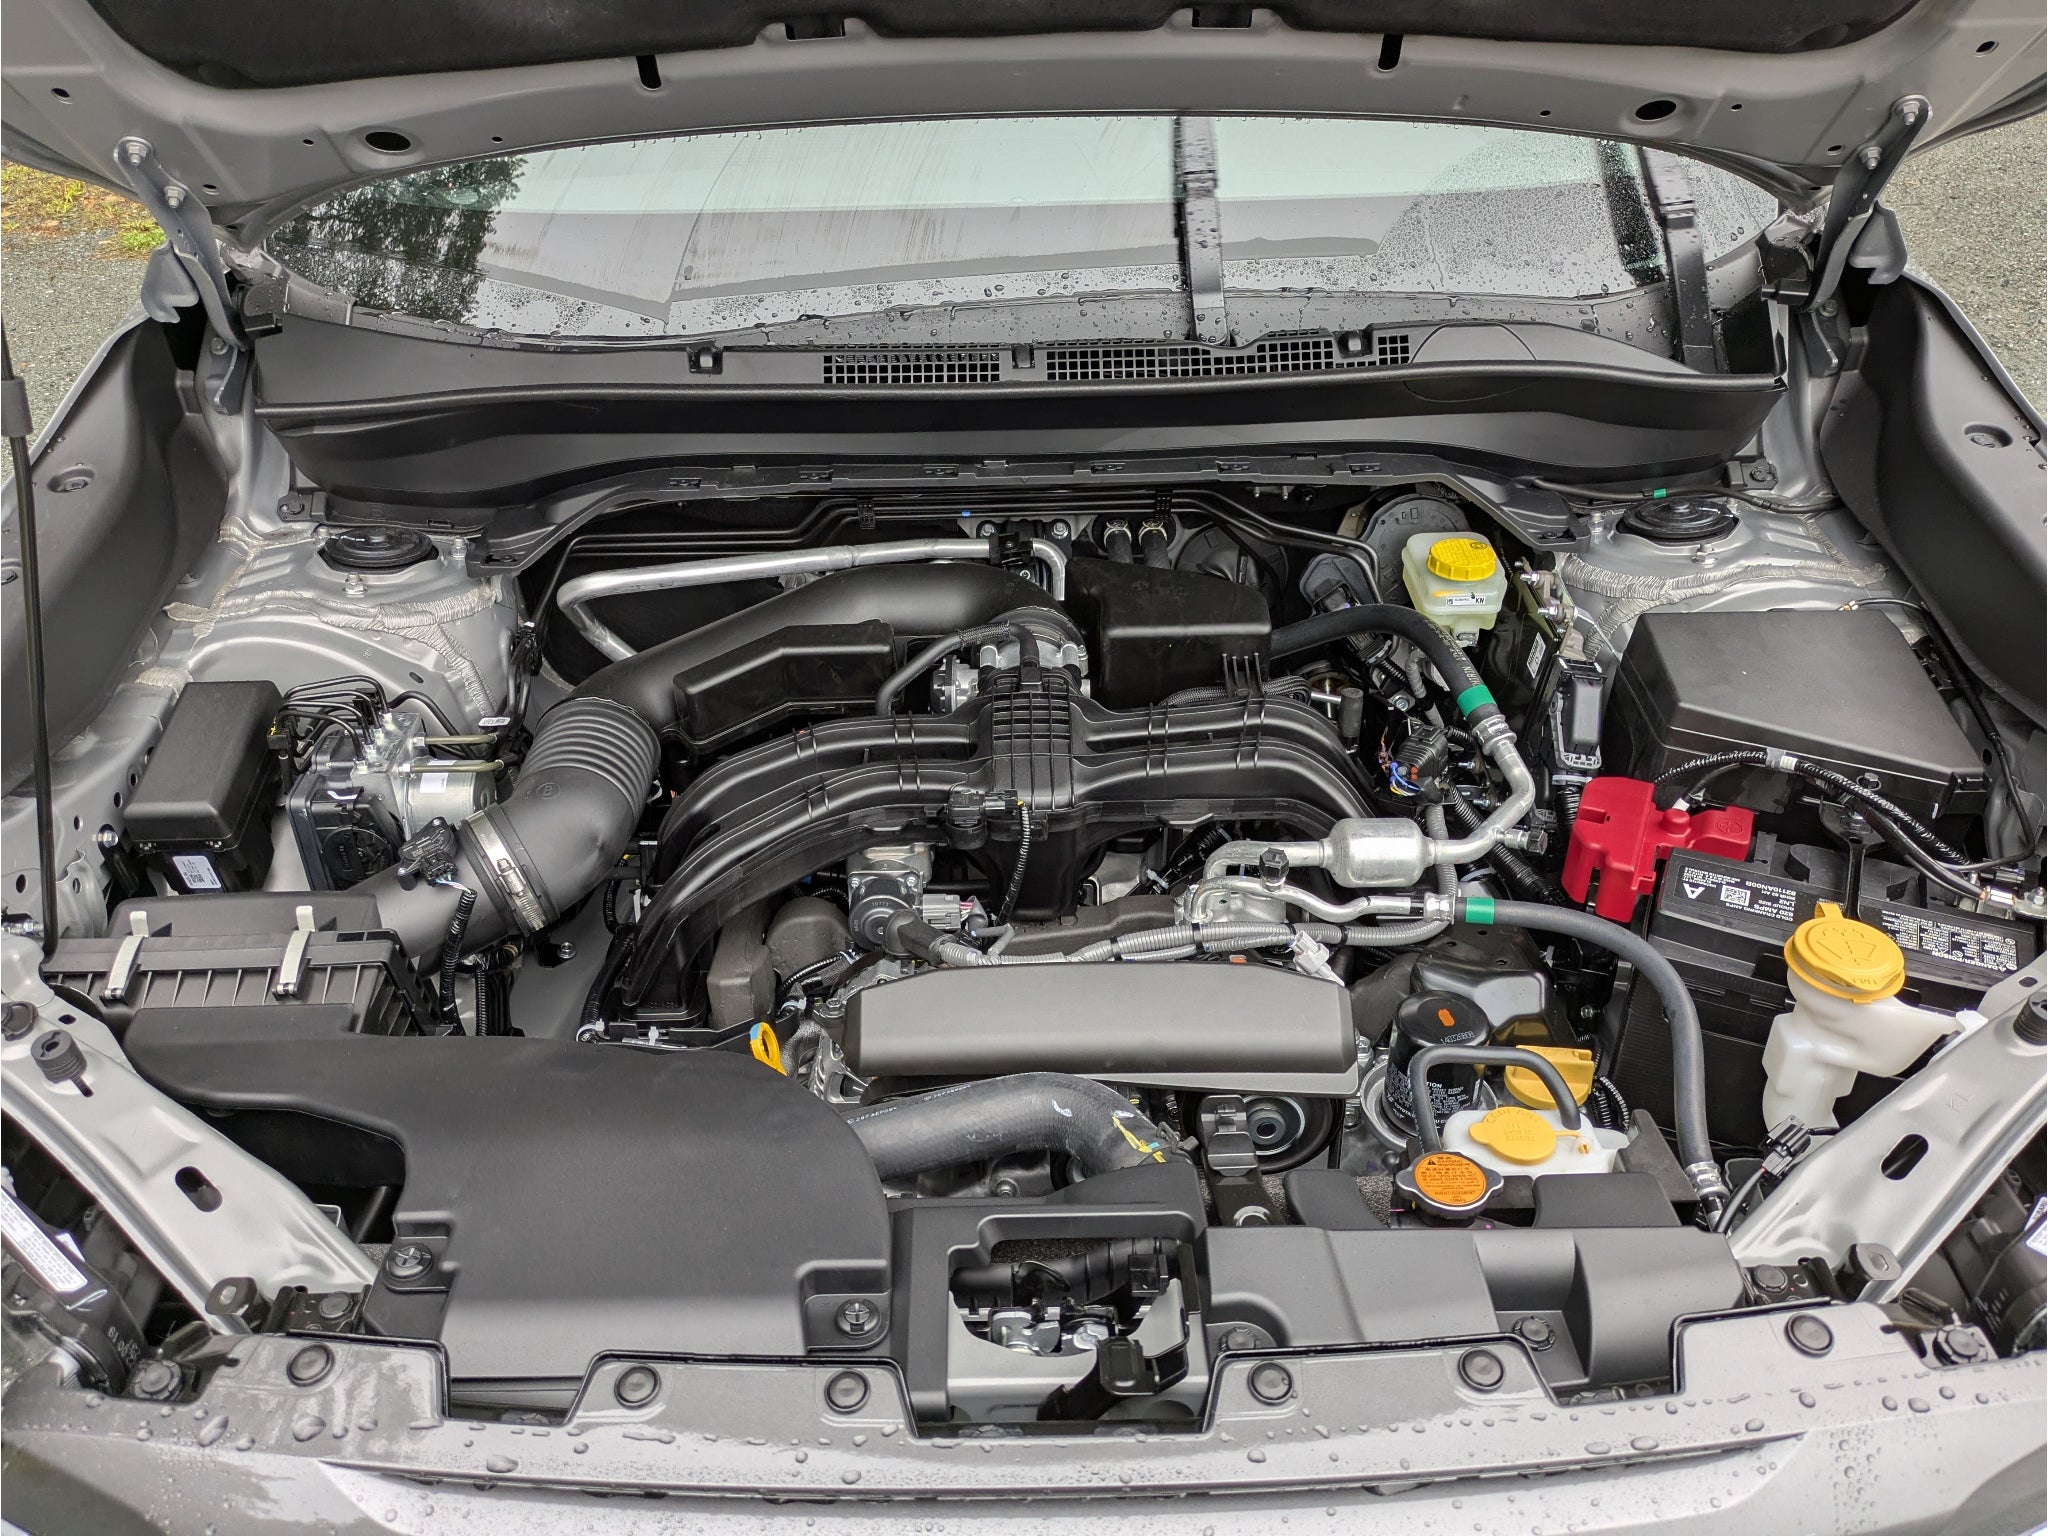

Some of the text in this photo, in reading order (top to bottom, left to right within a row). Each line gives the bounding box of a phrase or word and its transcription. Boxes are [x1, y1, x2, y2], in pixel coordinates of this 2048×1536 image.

[1725, 902, 1794, 922] COLD CRANKING AMPS
[1753, 903, 1778, 914] AMPS
